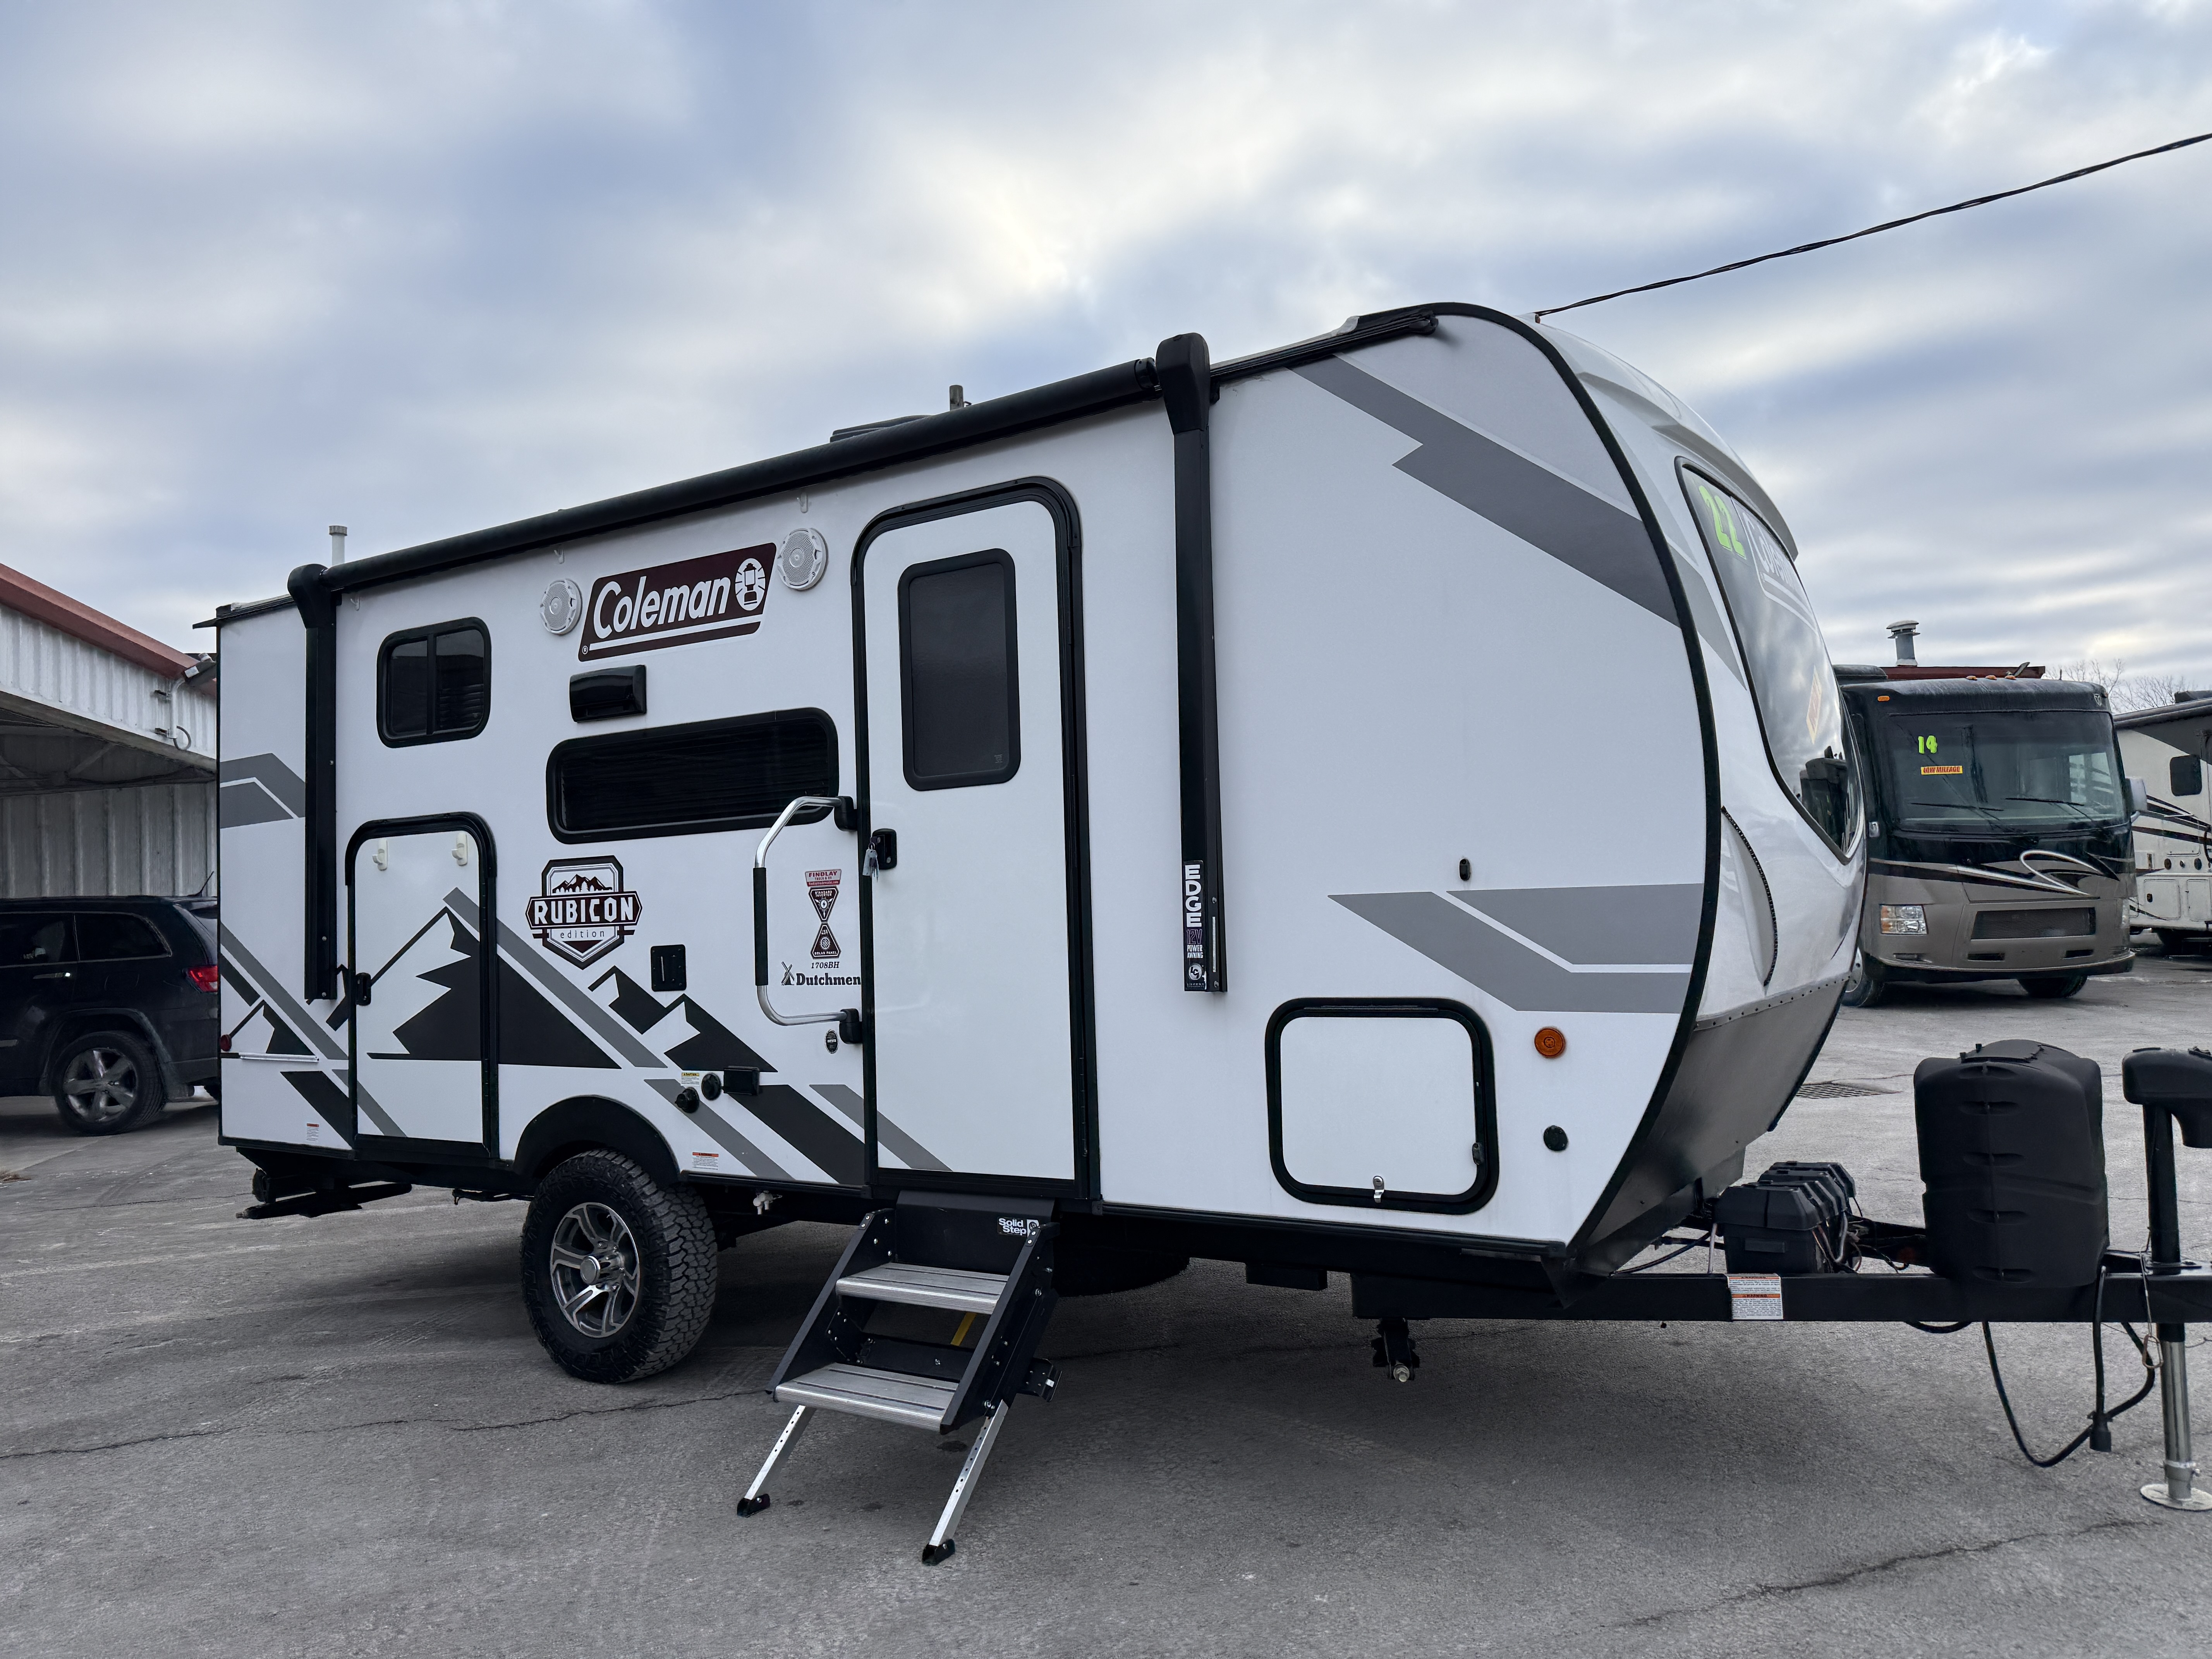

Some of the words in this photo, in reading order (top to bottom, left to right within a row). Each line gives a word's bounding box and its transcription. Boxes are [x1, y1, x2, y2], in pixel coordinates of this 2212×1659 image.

[1698, 485, 1747, 560] 22
[593, 575, 731, 639] Coleman
[1918, 735, 1938, 754] 14
[1185, 864, 1202, 927] EDGE
[534, 897, 633, 924] RUBICON
[560, 929, 605, 938] edition
[1187, 929, 1202, 945] 12V
[796, 972, 861, 986] Dutchmen
[998, 1218, 1024, 1227] Solid
[1002, 1225, 1027, 1236] Step
